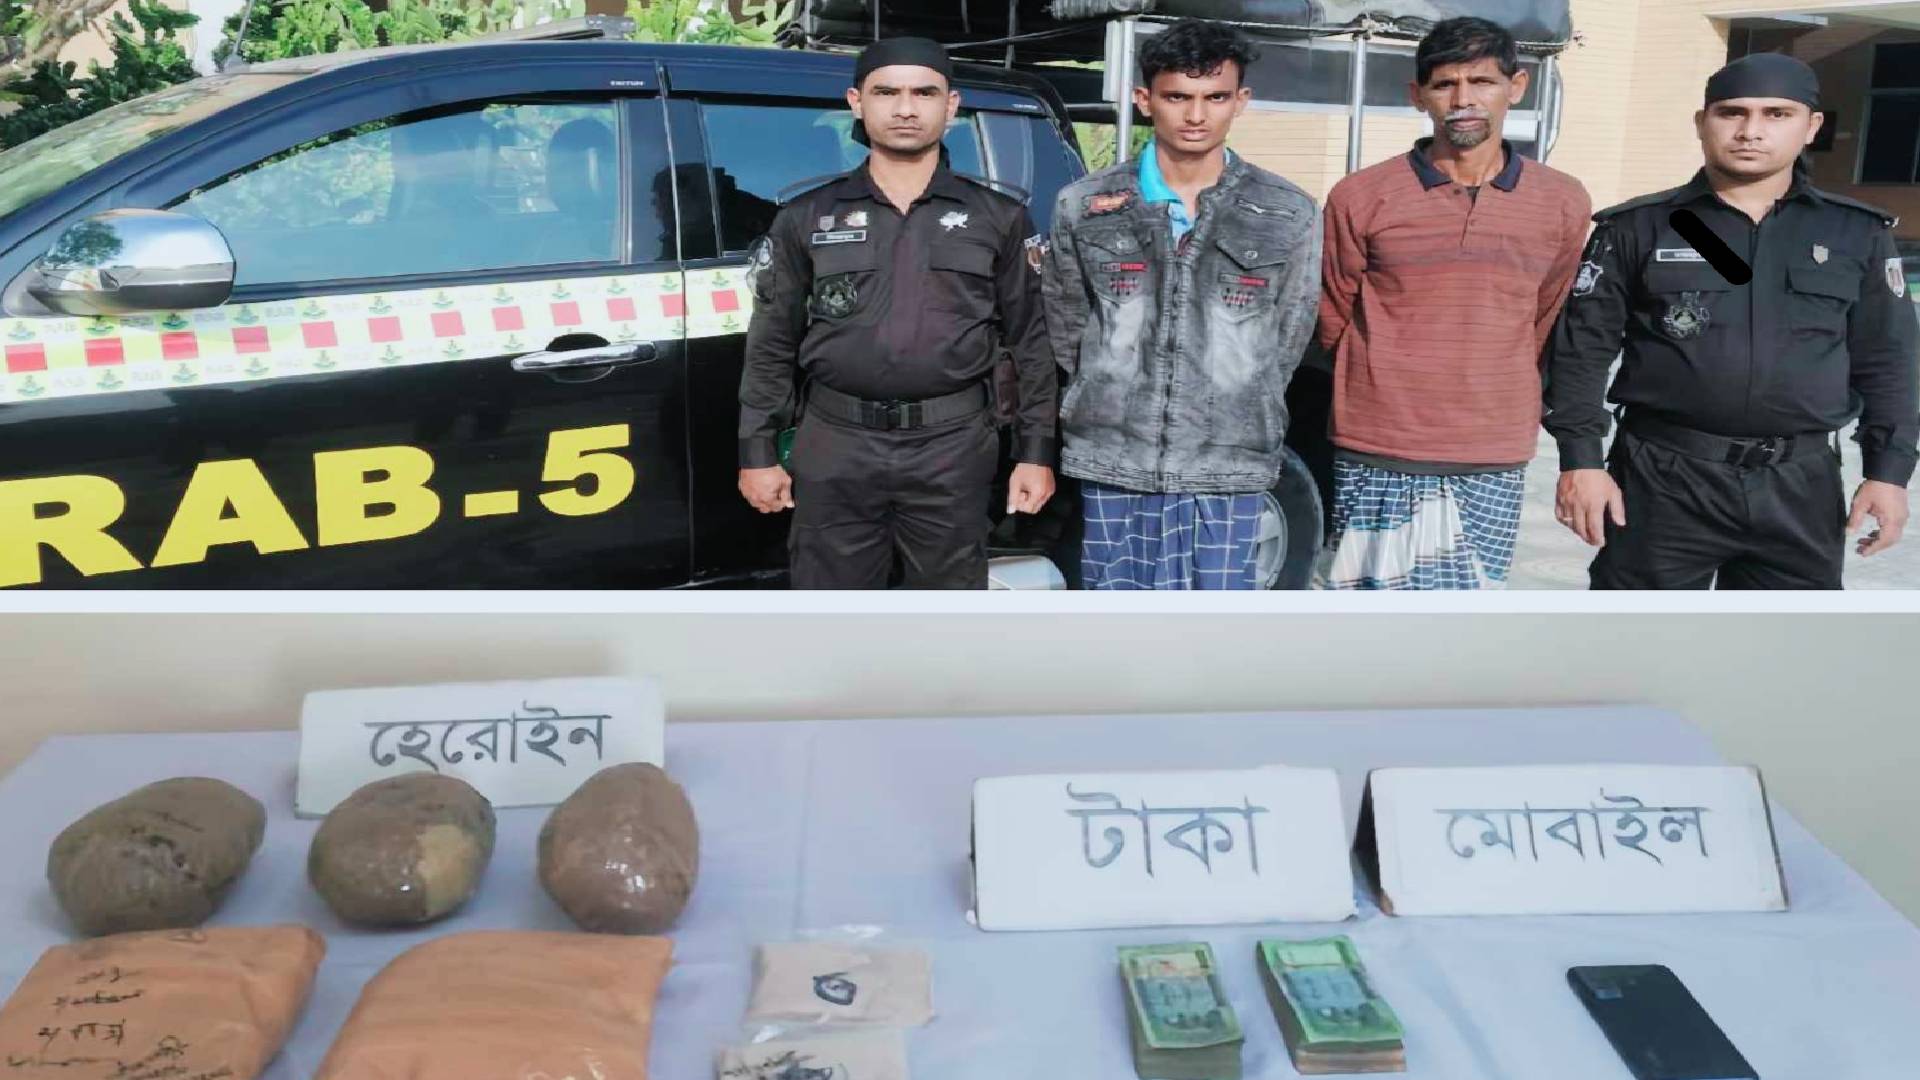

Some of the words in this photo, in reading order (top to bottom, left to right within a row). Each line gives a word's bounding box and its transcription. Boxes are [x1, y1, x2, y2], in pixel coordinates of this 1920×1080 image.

[0, 424, 635, 587] RAB-5
[364, 700, 612, 772] হেরোইন
[1065, 782, 1270, 877] টাকা
[1433, 787, 1711, 865] মোবাইল
